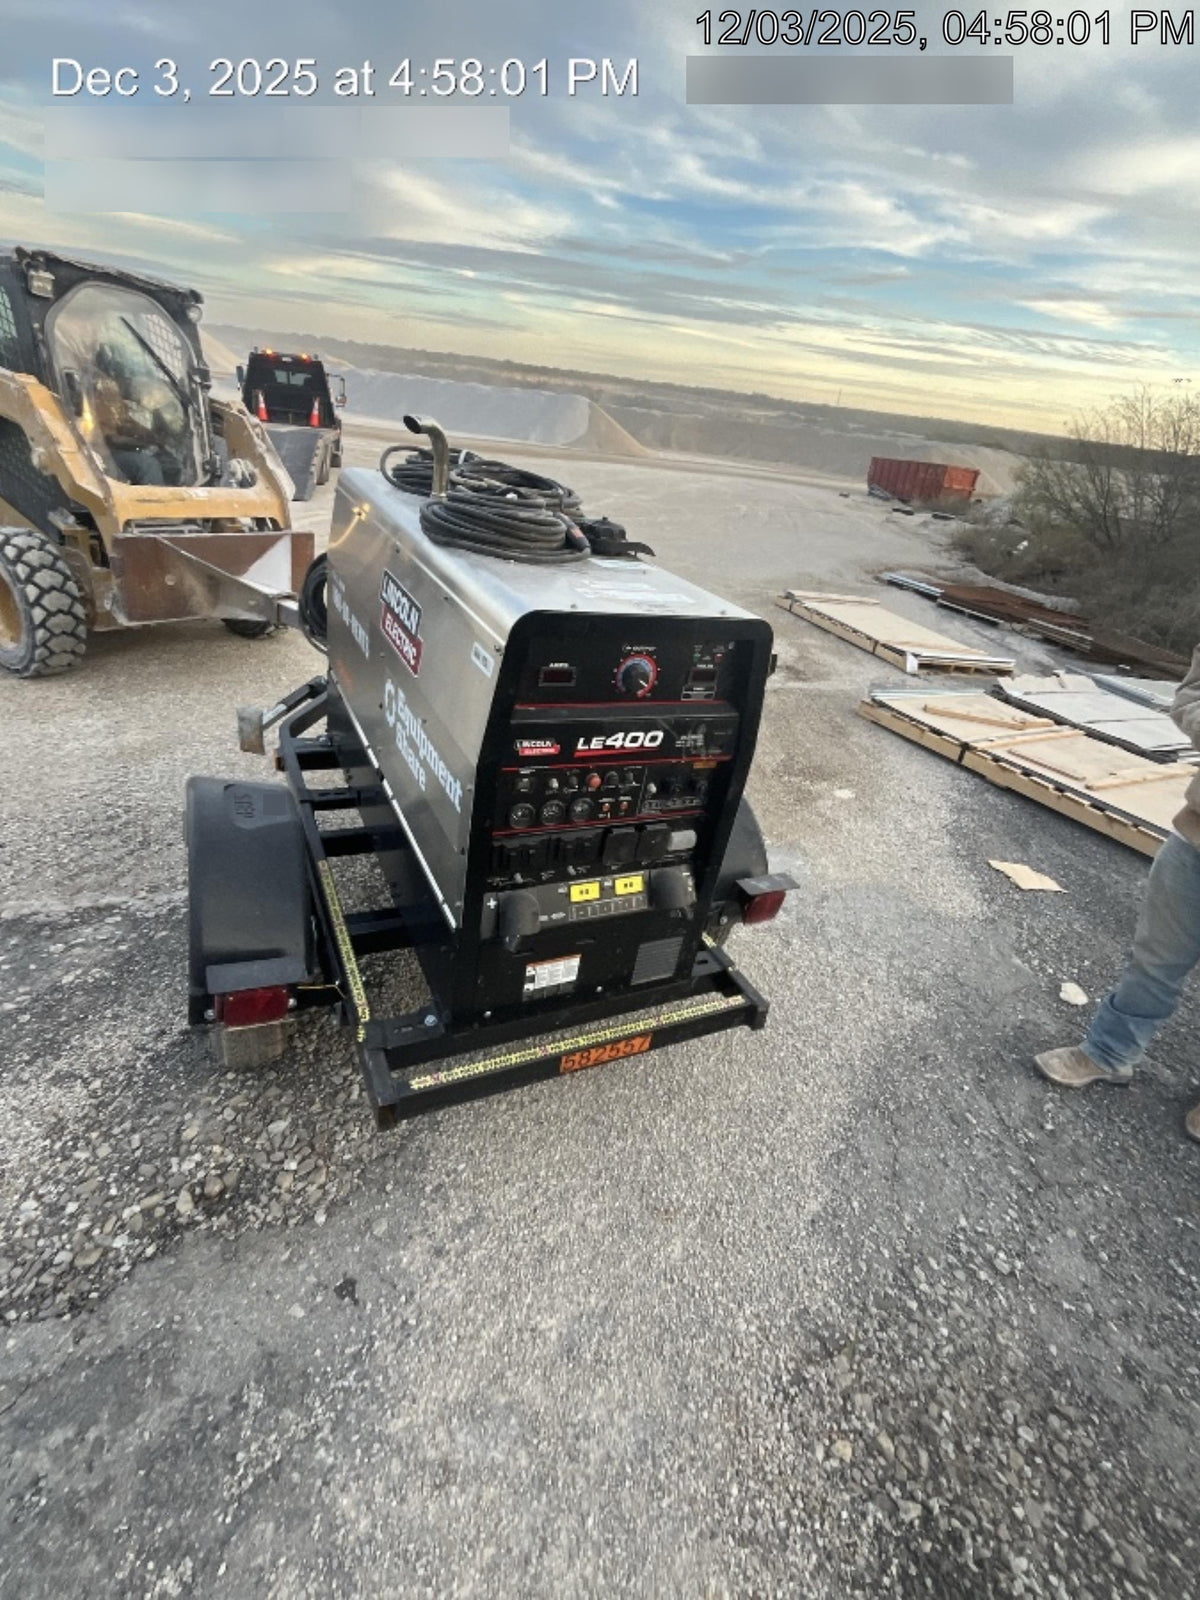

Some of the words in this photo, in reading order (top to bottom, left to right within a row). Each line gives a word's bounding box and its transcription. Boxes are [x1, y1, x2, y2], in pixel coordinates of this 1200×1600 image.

[383, 576, 422, 637] LINCOLN
[384, 611, 418, 667] ELECTRIC
[397, 686, 463, 815] Equipment
[516, 739, 553, 748] LINCOLN
[577, 730, 665, 750] LE400
[562, 1034, 652, 1072] 582557
